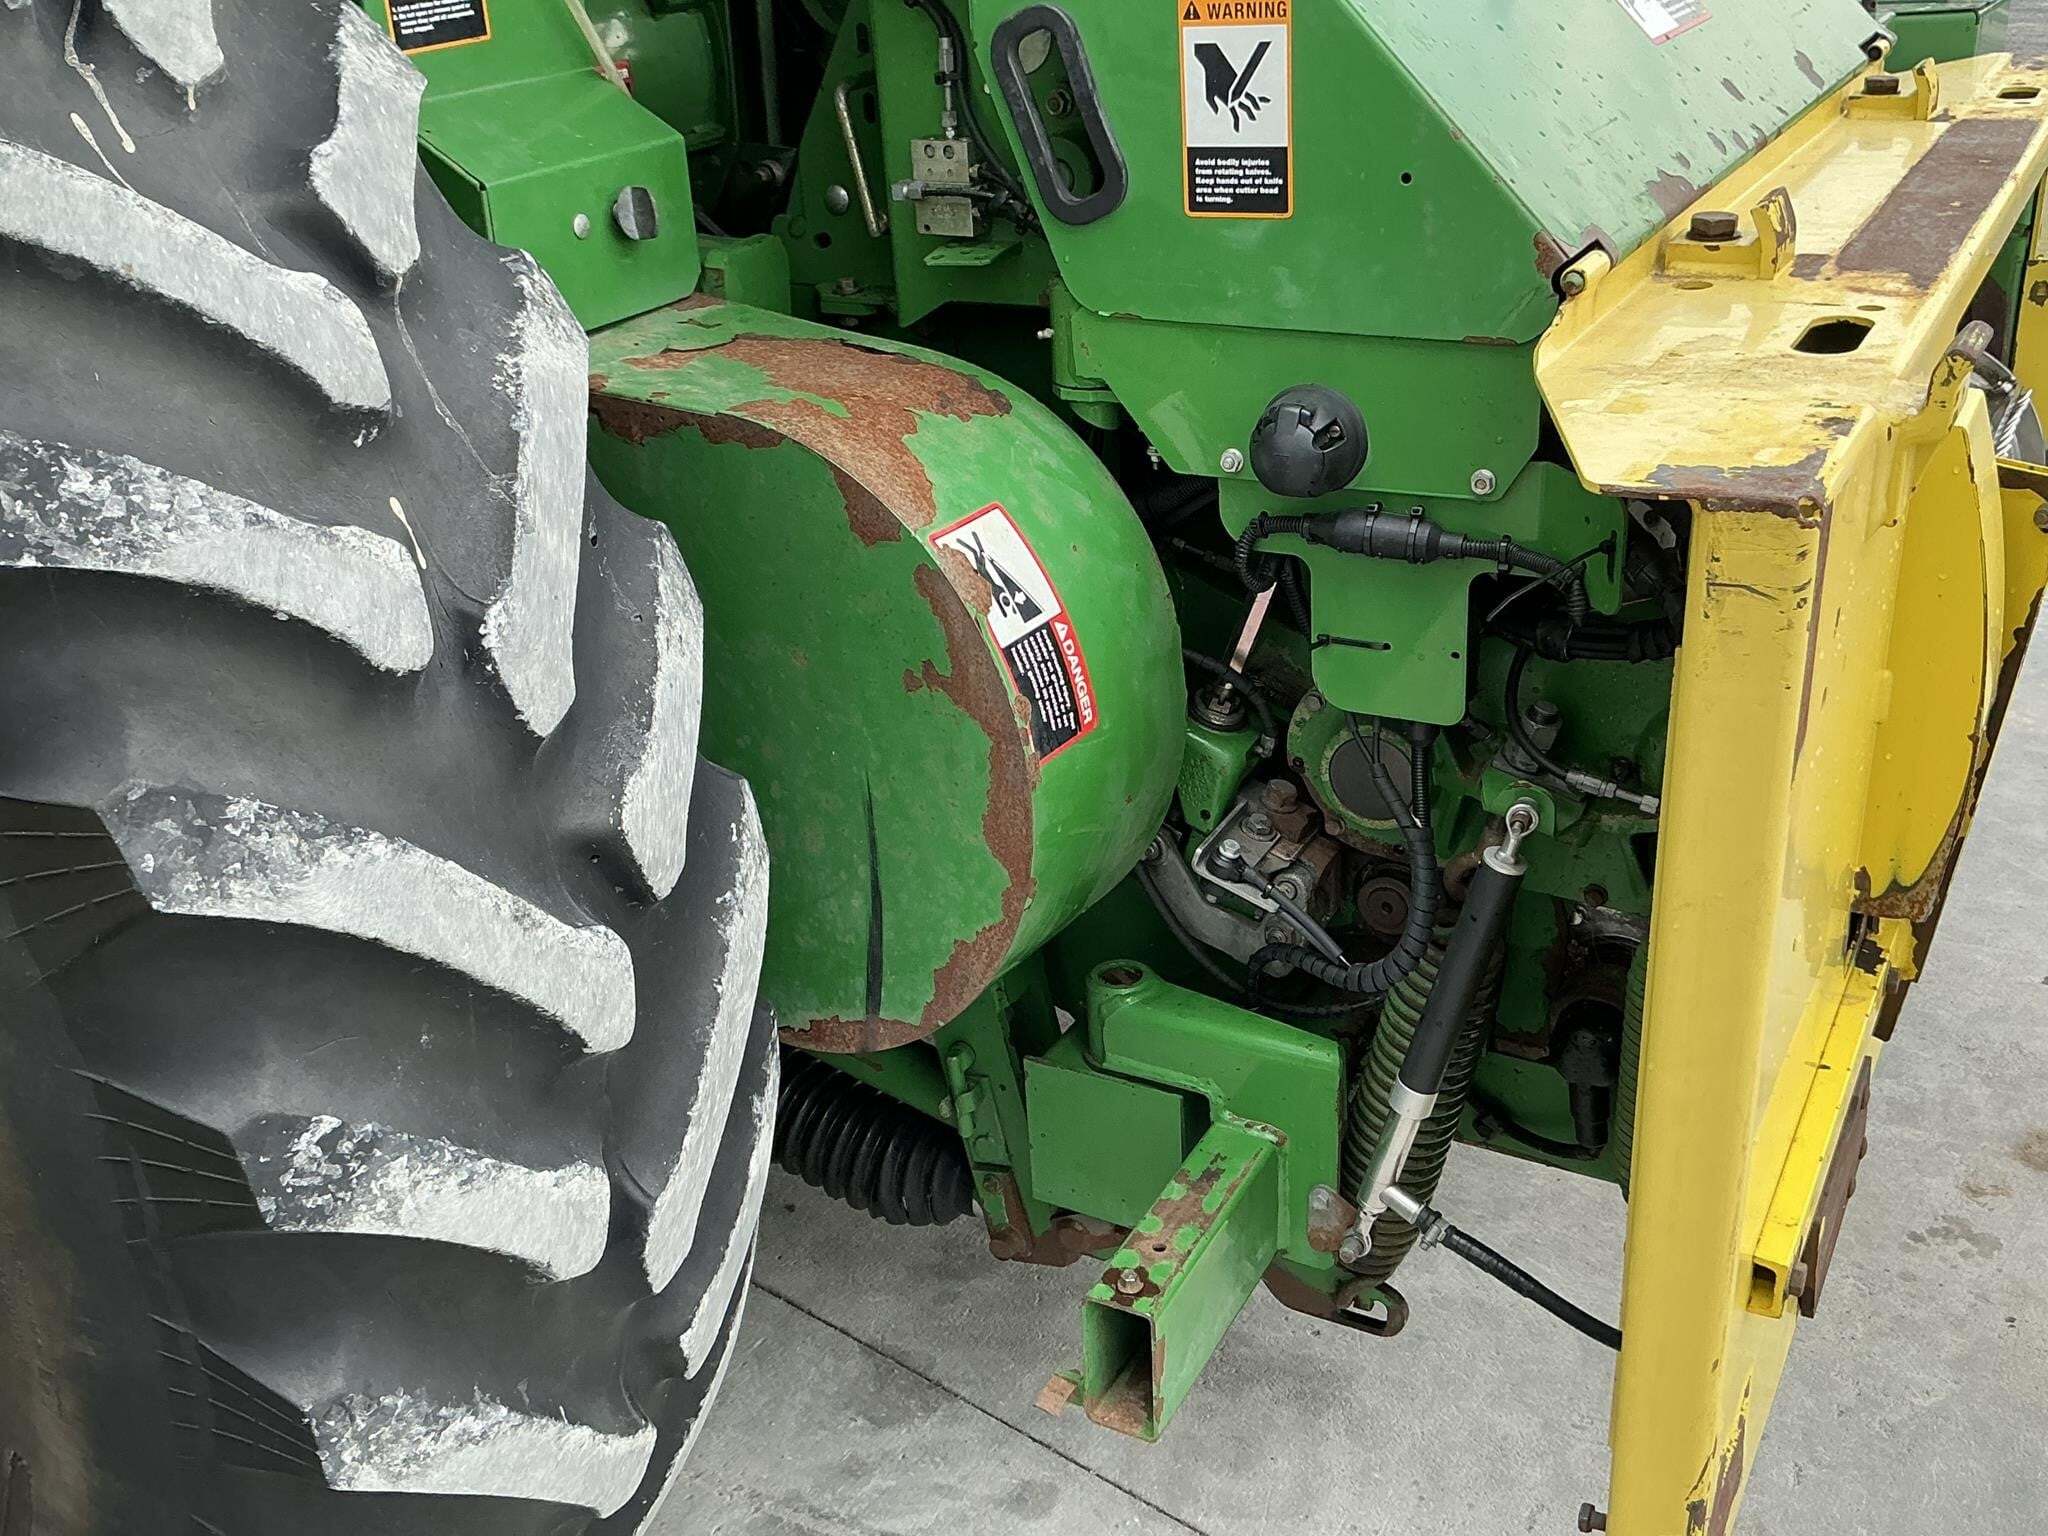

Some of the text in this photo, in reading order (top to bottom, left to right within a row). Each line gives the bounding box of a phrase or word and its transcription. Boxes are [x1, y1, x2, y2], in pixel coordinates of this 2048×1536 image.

[1207, 1, 1287, 20] WARNING
[1195, 158, 1269, 167] Avoid bodily injuries
[1214, 168, 1243, 176] rotating
[1196, 177, 1214, 185] Keep
[1205, 196, 1233, 204] turning.
[1062, 639, 1093, 725] DANGER
